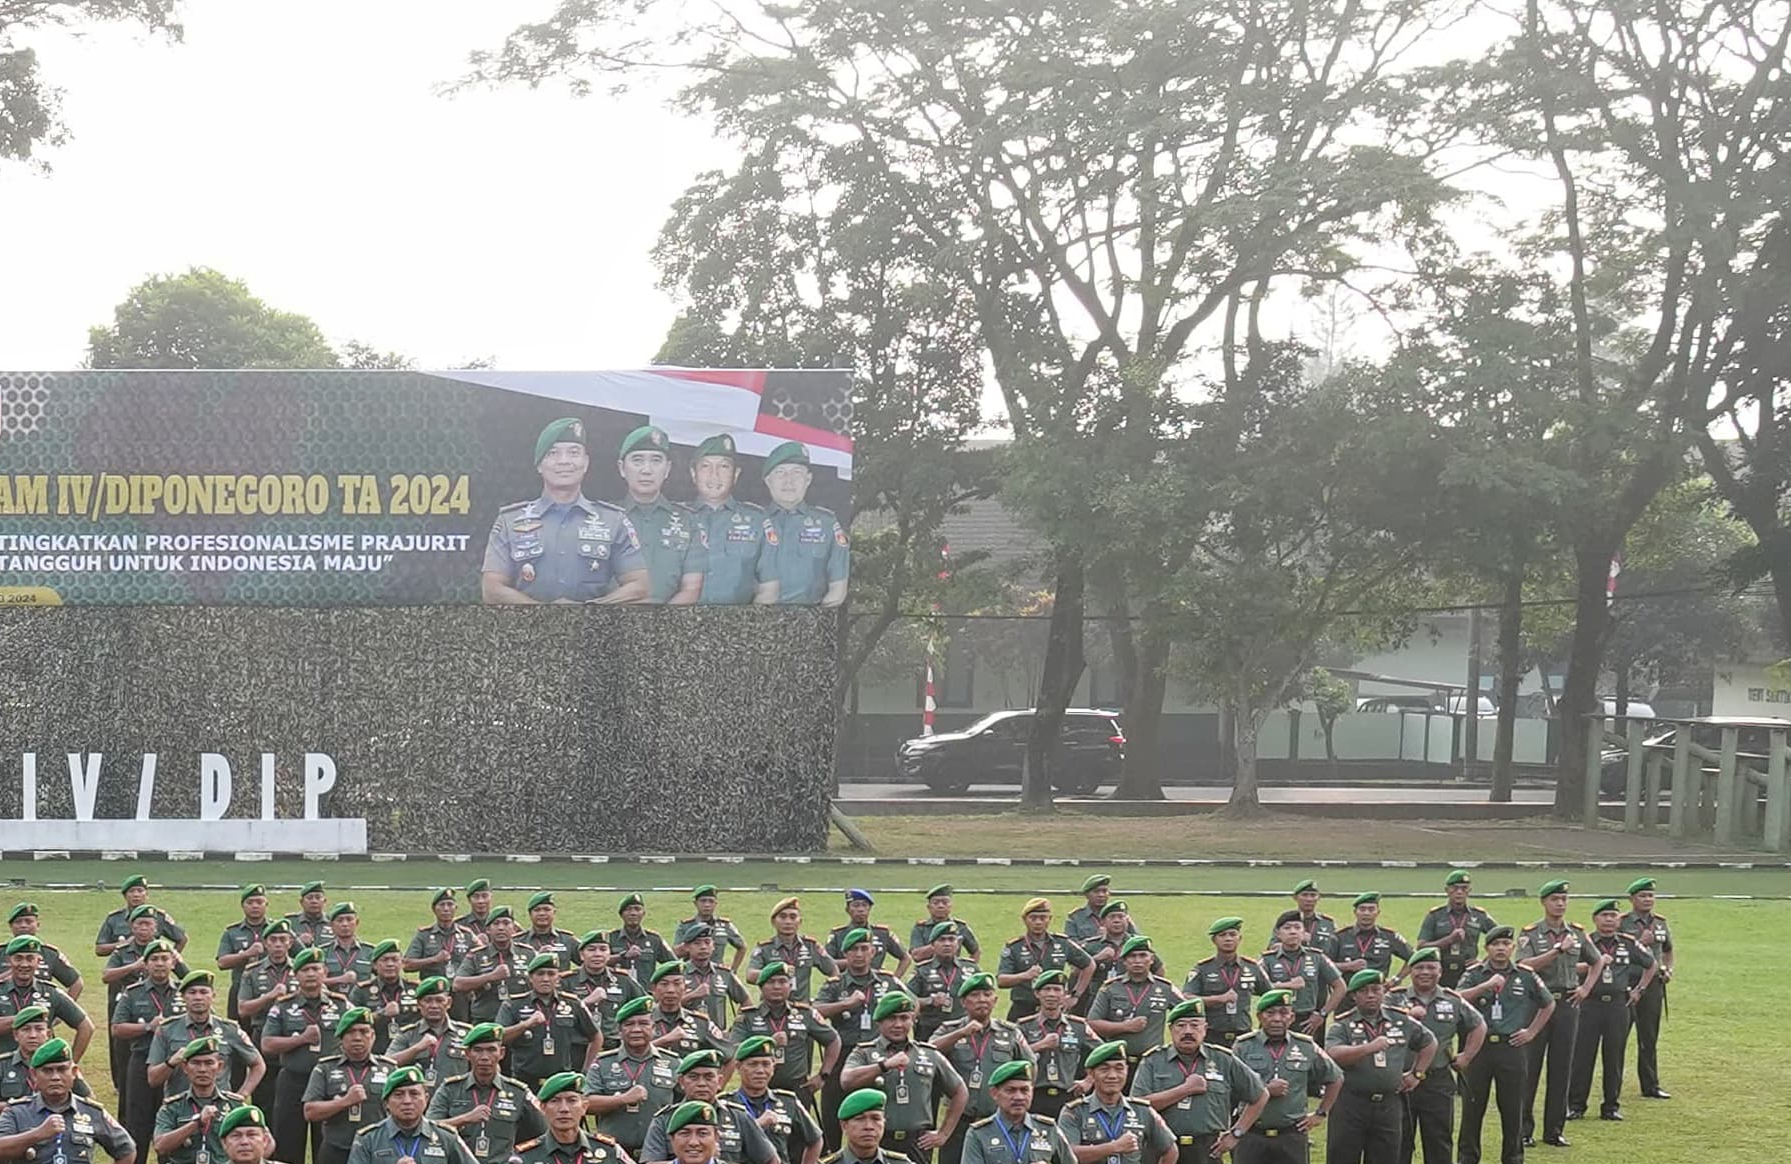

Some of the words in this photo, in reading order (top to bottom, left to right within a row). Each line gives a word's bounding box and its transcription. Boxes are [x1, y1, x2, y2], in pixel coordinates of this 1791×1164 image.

[337, 474, 381, 514] TA
[390, 474, 471, 514] 2024
[145, 535, 354, 551] PROFESIONALISME
[361, 535, 470, 551] PRAJURIT
[109, 555, 184, 571] UNTUK
[190, 555, 317, 571] INDONESIA
[8, 594, 37, 603] 2024
